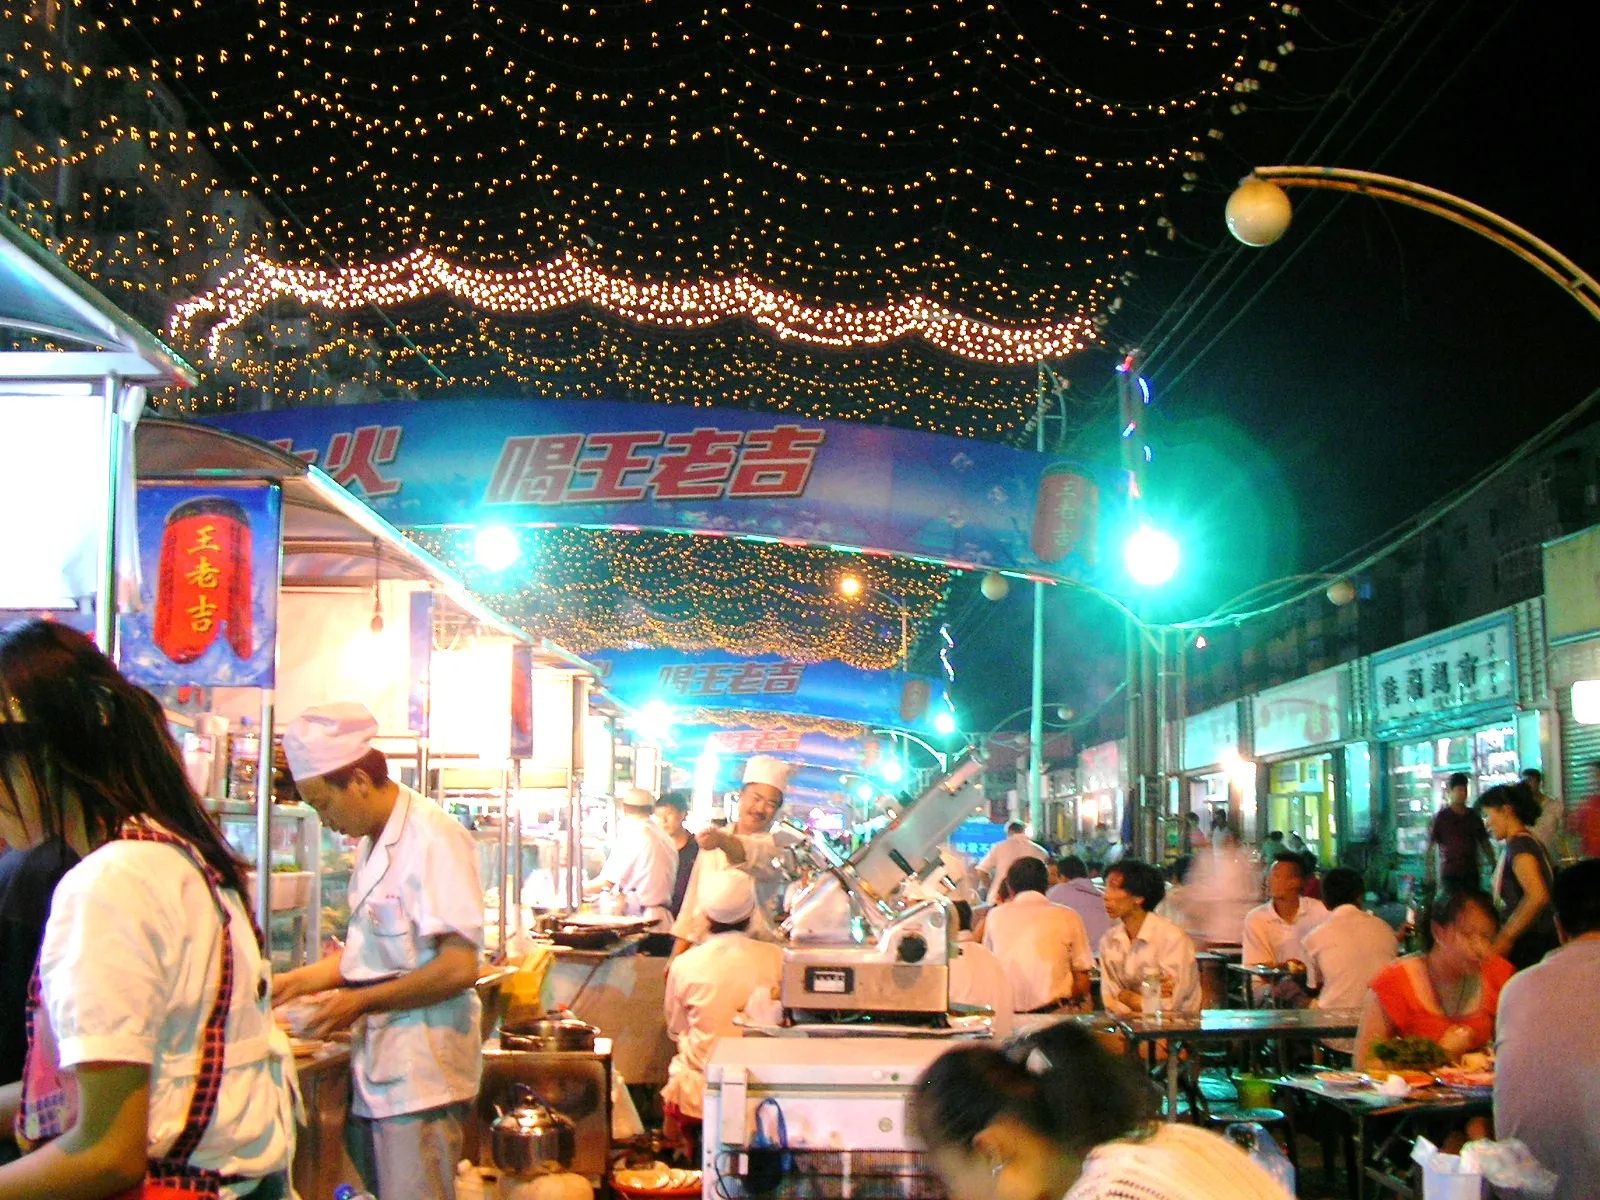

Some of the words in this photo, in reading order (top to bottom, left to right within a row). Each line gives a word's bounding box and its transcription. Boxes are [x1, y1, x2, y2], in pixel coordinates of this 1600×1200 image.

[484, 424, 826, 505] 喝王老吉
[185, 523, 222, 633] 王老吉
[659, 660, 807, 696] 喝王老吉
[713, 728, 803, 753] 王老吉
